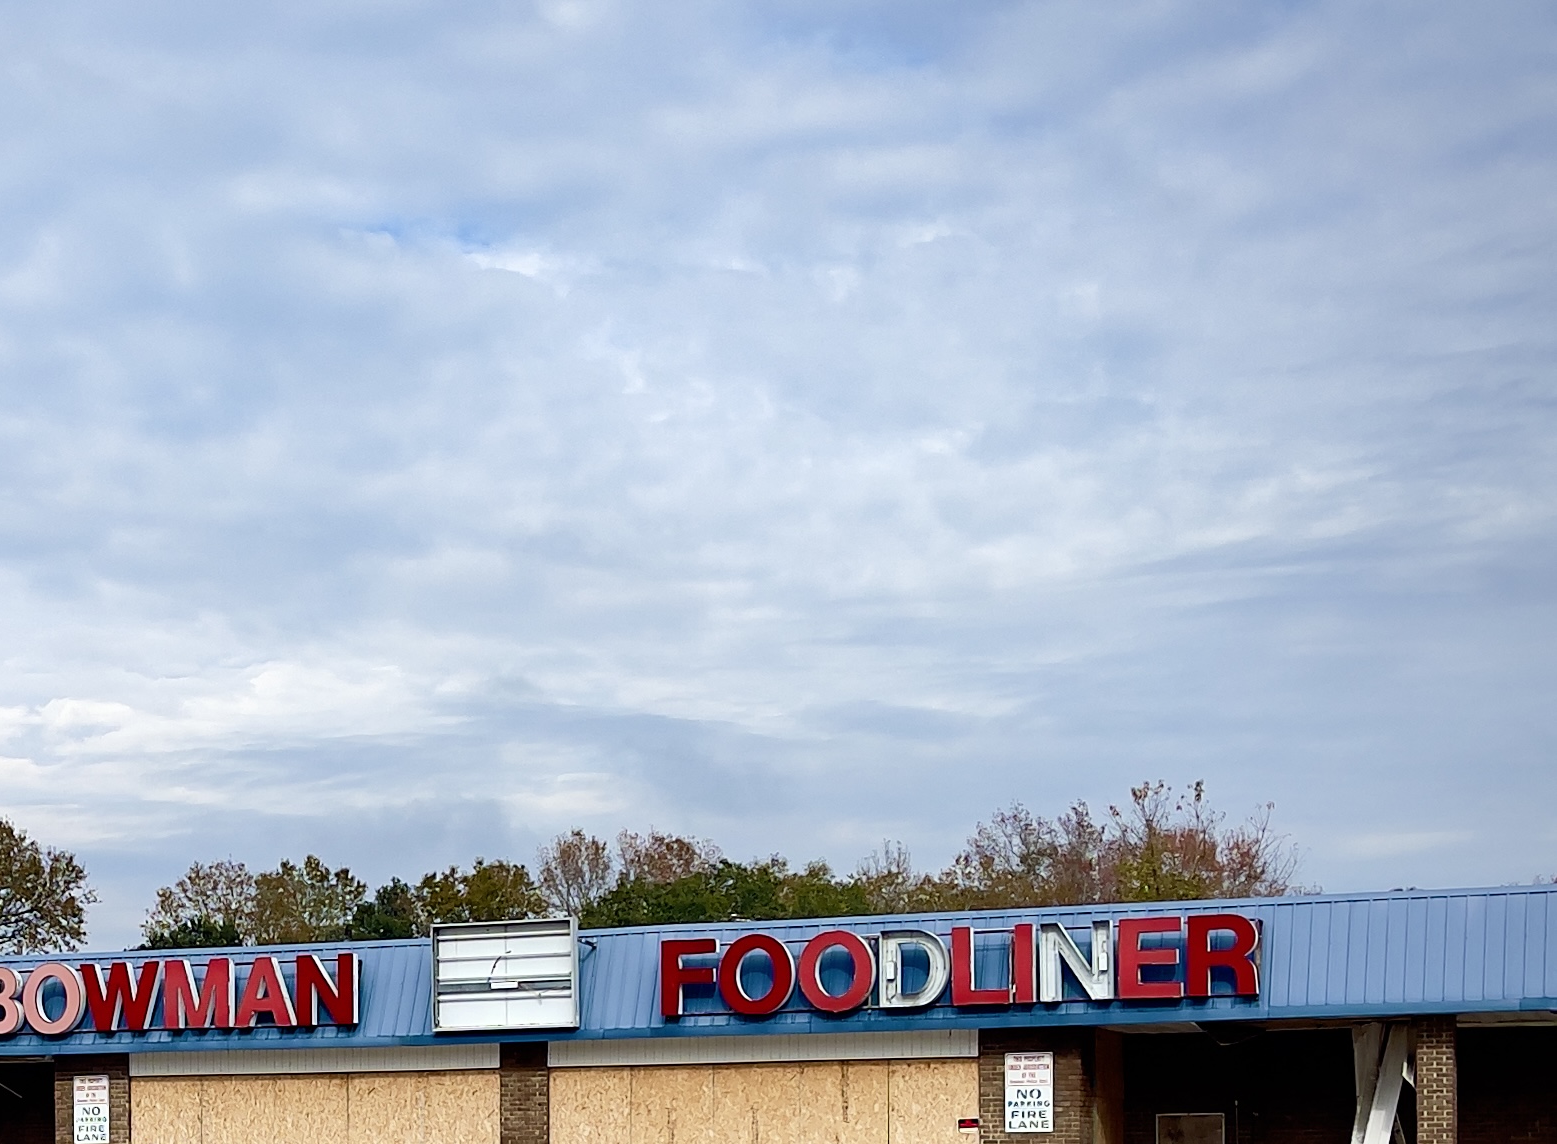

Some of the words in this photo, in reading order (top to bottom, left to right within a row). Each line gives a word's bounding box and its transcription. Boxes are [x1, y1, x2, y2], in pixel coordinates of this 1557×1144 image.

[660, 913, 1264, 1016] FOODLINER
[1016, 1088, 1042, 1099] NO
[82, 1106, 101, 1116] NO
[1011, 1110, 1047, 1119] FIRE
[1008, 1120, 1049, 1129] LANE
[76, 1133, 107, 1142] LANE
